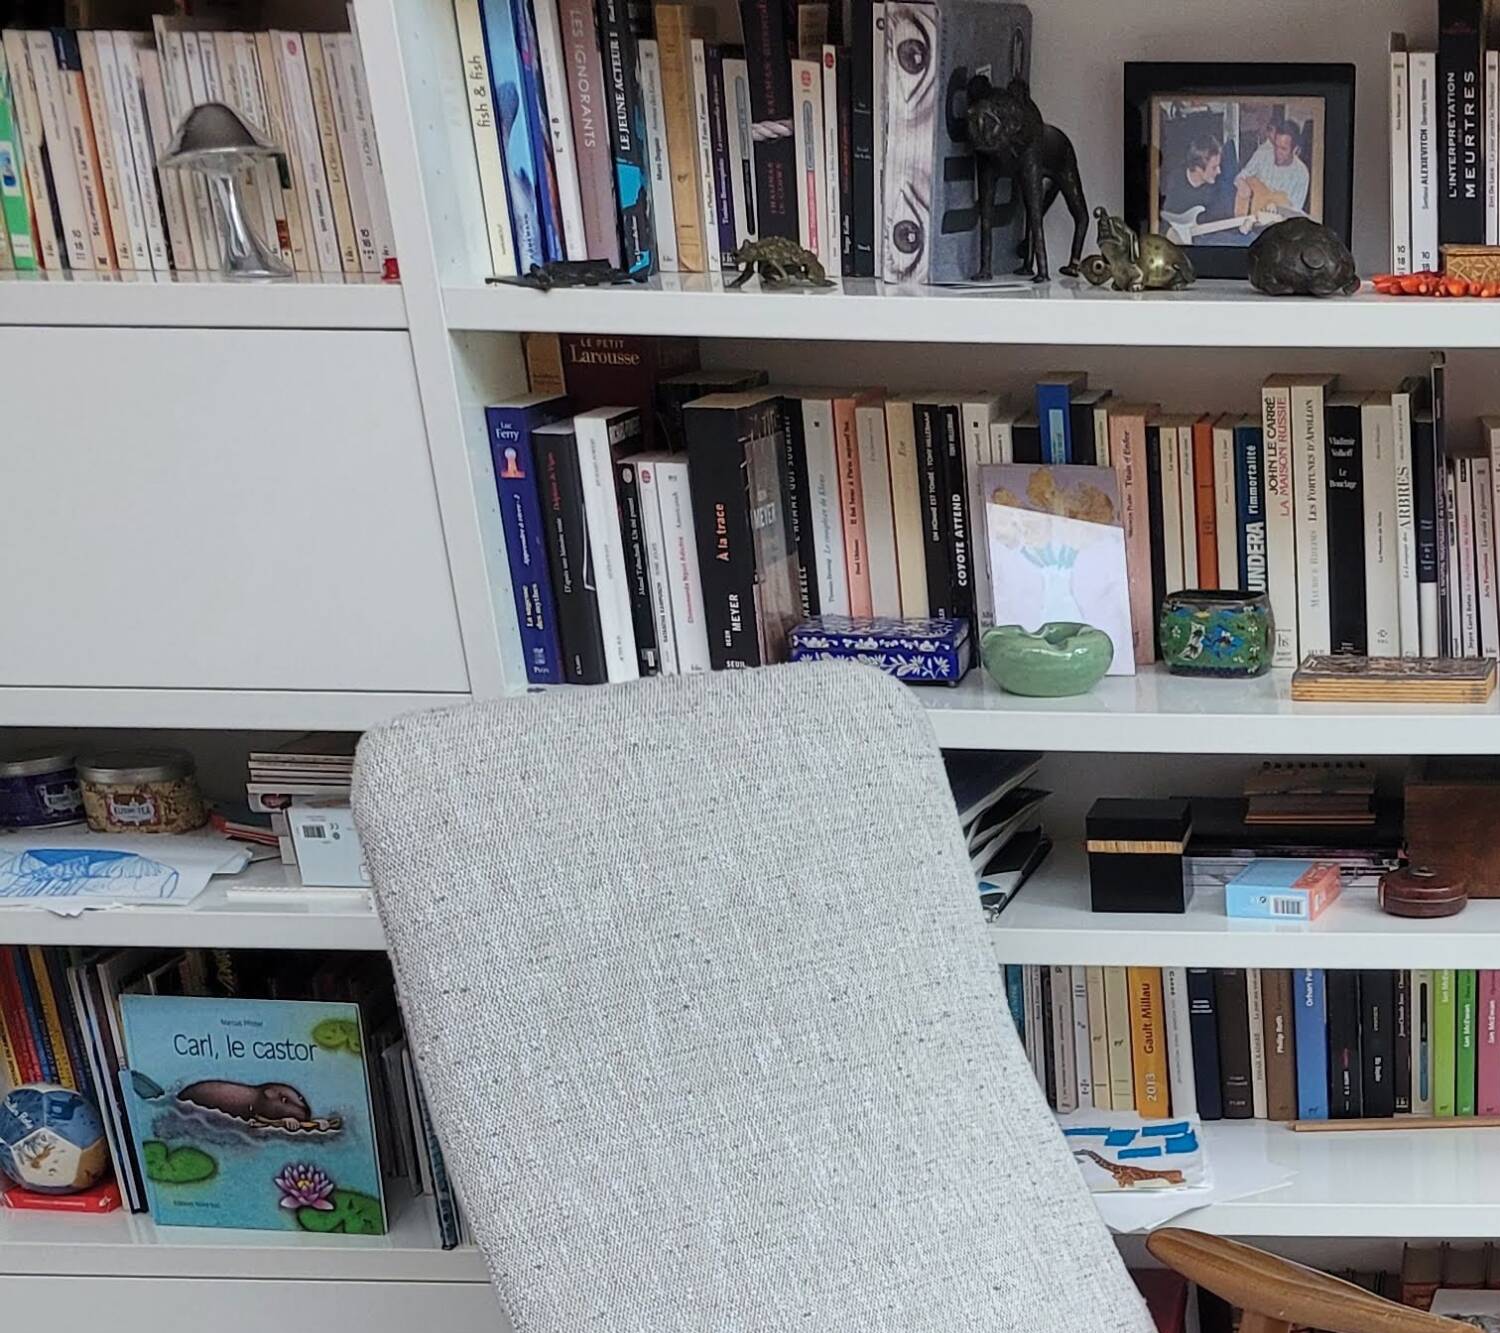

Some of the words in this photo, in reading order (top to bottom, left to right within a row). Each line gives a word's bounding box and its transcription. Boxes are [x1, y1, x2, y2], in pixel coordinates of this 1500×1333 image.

[571, 9, 584, 36] LES
[469, 55, 483, 79] fish
[611, 41, 624, 91] ACTEUR
[474, 85, 486, 97] &
[575, 44, 596, 148] IGNORANTS
[477, 103, 490, 127] fish
[617, 92, 630, 133] JEUNE
[620, 134, 630, 150] LE
[1447, 72, 1457, 198] L'INTERPRÉTATION
[1464, 71, 1476, 198] MEURTRES
[571, 346, 641, 366] Larousse
[1264, 397, 1276, 439] CARRÉ
[1277, 397, 1288, 443] RUSSIE
[1303, 399, 1315, 451] D'APOLLON
[495, 429, 519, 441] Ferry
[1266, 441, 1277, 457] LE
[1328, 436, 1356, 446] Vladimir
[926, 449, 934, 466] TONY
[1331, 448, 1354, 457] Volkoff
[1267, 460, 1278, 495] JOHN
[1277, 447, 1289, 496] MAISON
[1305, 454, 1316, 501] FORTUNES
[1329, 479, 1358, 489] Bouclage
[930, 494, 938, 505] EST
[1280, 500, 1290, 516] LA
[1397, 466, 1411, 530] ARBRES
[714, 503, 727, 535] trace
[952, 494, 964, 538] ATTEND
[1307, 504, 1316, 522] LES
[717, 552, 730, 561] À
[718, 538, 728, 549] la
[956, 541, 966, 586] COYOTE
[522, 585, 533, 615] sagesse
[530, 584, 543, 613] mythes
[1309, 569, 1321, 607] MAURICE
[525, 618, 534, 627] La
[535, 615, 544, 630] des
[729, 594, 742, 631] MEYER
[727, 660, 745, 668] SEUIL
[1139, 983, 1151, 1020] Millau
[1305, 983, 1313, 1006] Orhan
[1275, 1016, 1284, 1032] Roth
[1463, 1004, 1471, 1034] McEwan
[1488, 1000, 1496, 1030] McEwan
[173, 1032, 219, 1061] Carl,
[226, 1033, 245, 1059] le
[252, 1040, 317, 1062] castor
[1142, 1023, 1153, 1054] Gault
[1275, 1034, 1285, 1053] Philip
[1147, 1072, 1157, 1101] 2013
